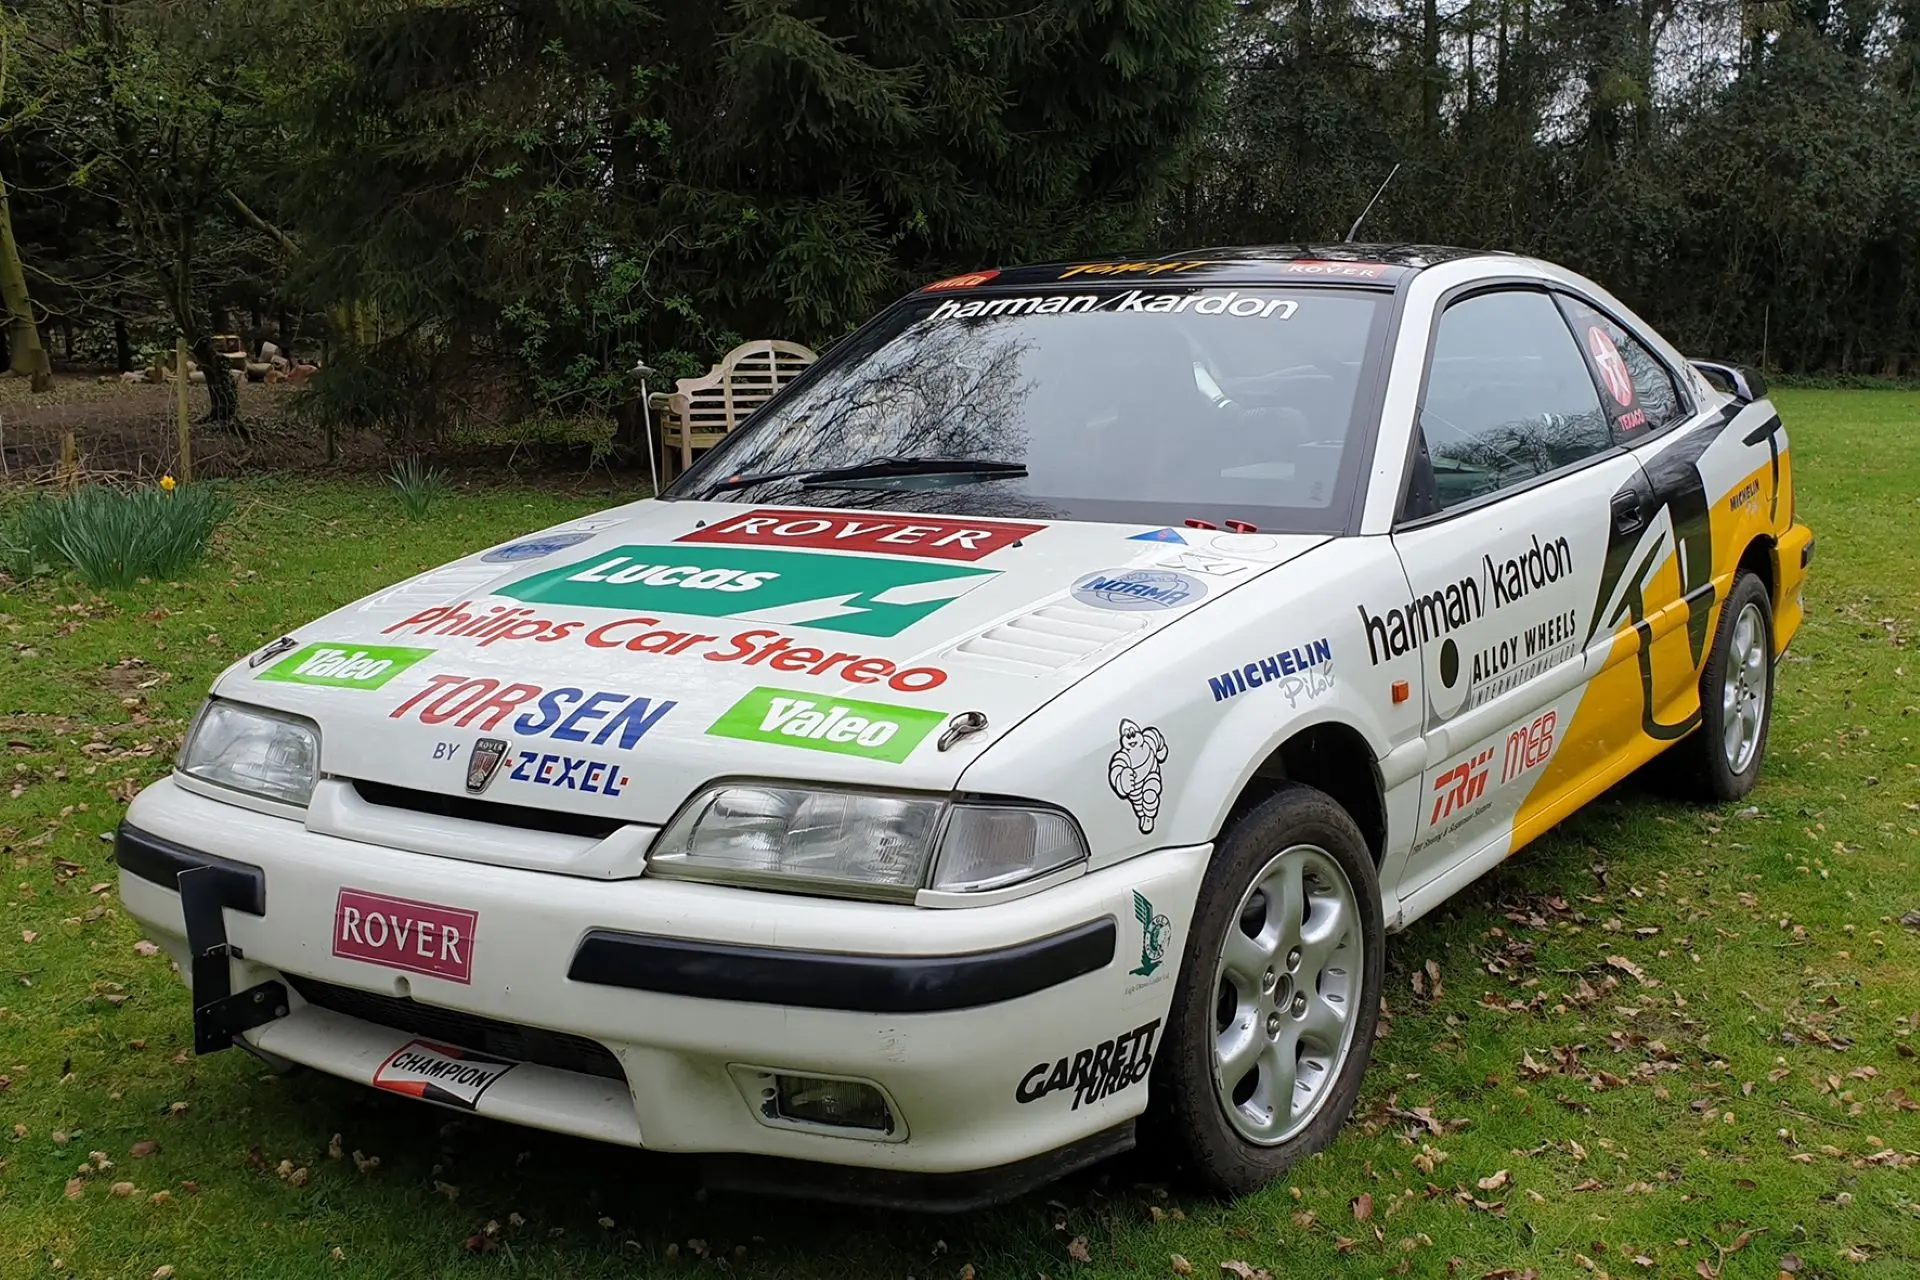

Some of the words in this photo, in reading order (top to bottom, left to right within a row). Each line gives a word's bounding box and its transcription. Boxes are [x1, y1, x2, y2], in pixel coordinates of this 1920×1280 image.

[1289, 264, 1374, 277] ROVER
[926, 290, 1299, 321] harman/kardon
[718, 517, 992, 550] ROVER
[567, 557, 783, 592] Lucas
[1081, 576, 1189, 605] NORMA
[1358, 534, 1572, 665] harman/kardon
[294, 648, 393, 681] Valeo
[380, 601, 585, 647] Philips
[585, 617, 706, 656] Car
[704, 629, 948, 692] Stereo
[1208, 638, 1332, 701] MICHELIN
[1473, 636, 1518, 685] ALLOY
[1524, 609, 1576, 658] WHEELS
[389, 674, 678, 750] TORSEN
[759, 697, 901, 748] Valeo
[433, 743, 459, 760] BY
[510, 751, 620, 796] ZEXEL
[1429, 746, 1495, 826] TRW
[342, 906, 462, 964] ROVER
[392, 1052, 496, 1088] CHAMPION
[1016, 1017, 1162, 1104] GARRETT
[1072, 1055, 1152, 1111] TURBO
